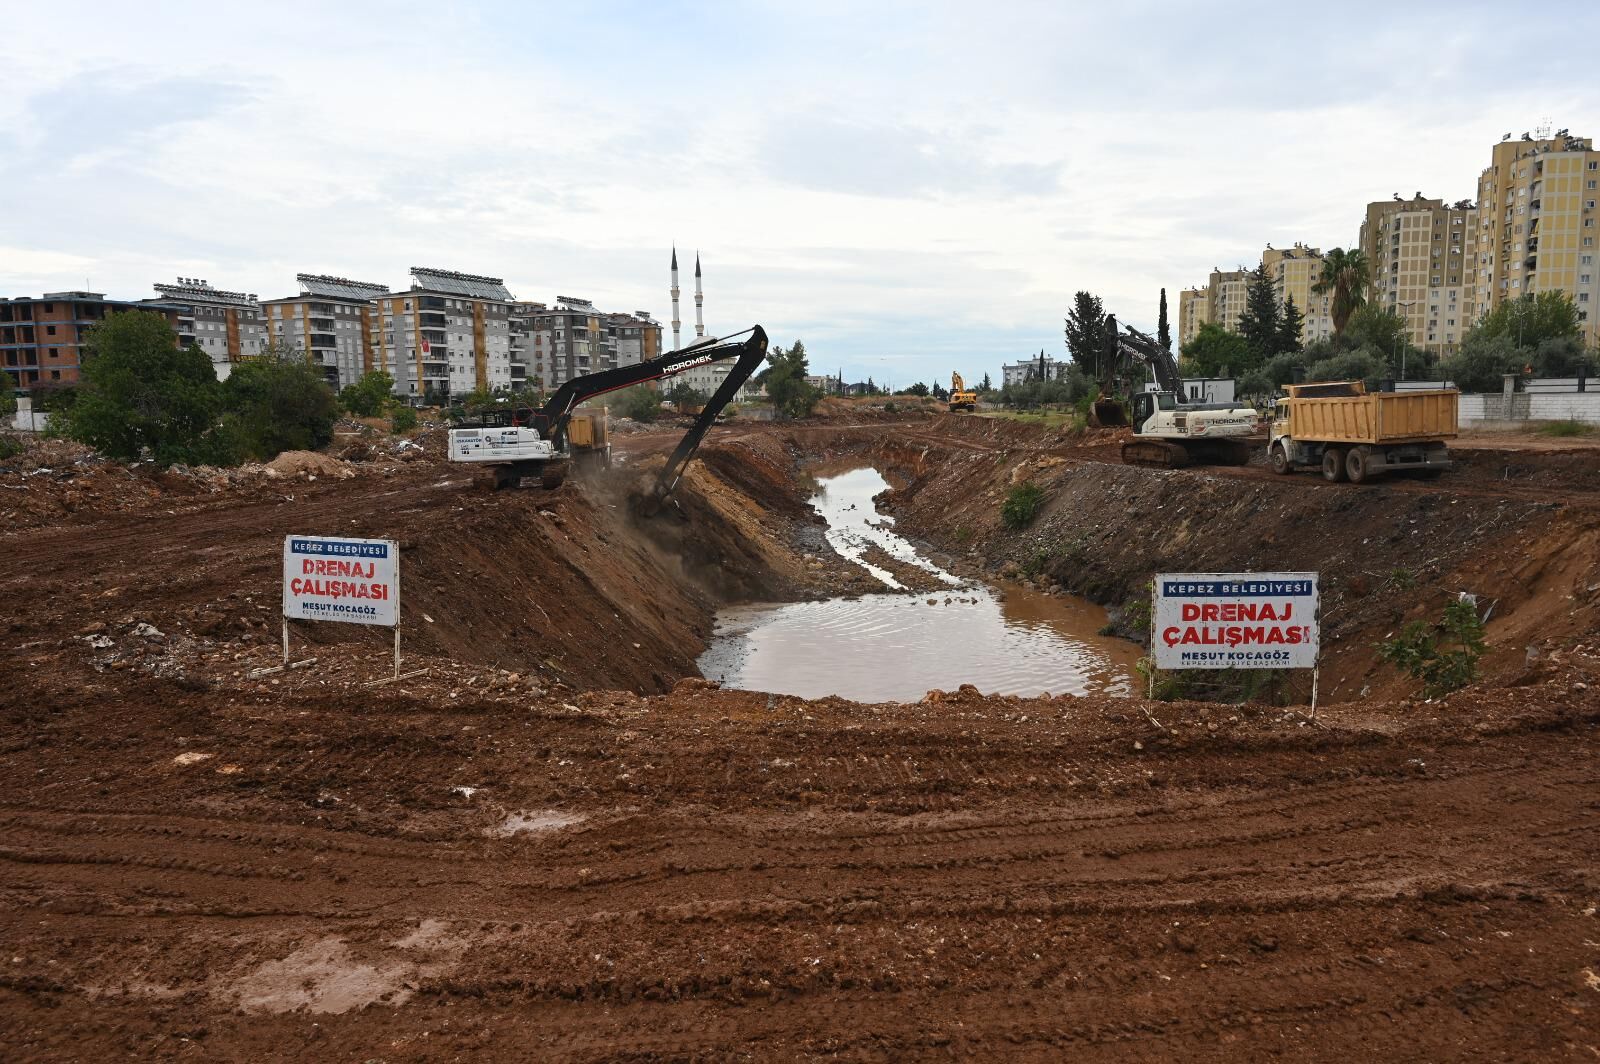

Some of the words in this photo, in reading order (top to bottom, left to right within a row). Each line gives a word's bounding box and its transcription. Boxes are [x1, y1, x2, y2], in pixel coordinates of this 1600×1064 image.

[294, 543, 323, 552] KEPEZ
[327, 544, 385, 555] BELEDİYESİ
[302, 559, 375, 579] DRENAJ
[290, 578, 388, 600] ÇALIŞMASI
[1168, 585, 1215, 593] KEPEZ
[1222, 583, 1308, 593] BELEDİYESİ
[302, 602, 331, 611] MESUT
[333, 604, 376, 615] KOCAGÖZ
[1182, 602, 1293, 622] DRENAJ
[1162, 625, 1310, 648] ÇALIŞMASI
[1181, 652, 1225, 660] MESUT
[1227, 649, 1290, 660] KOCAGÖZ
